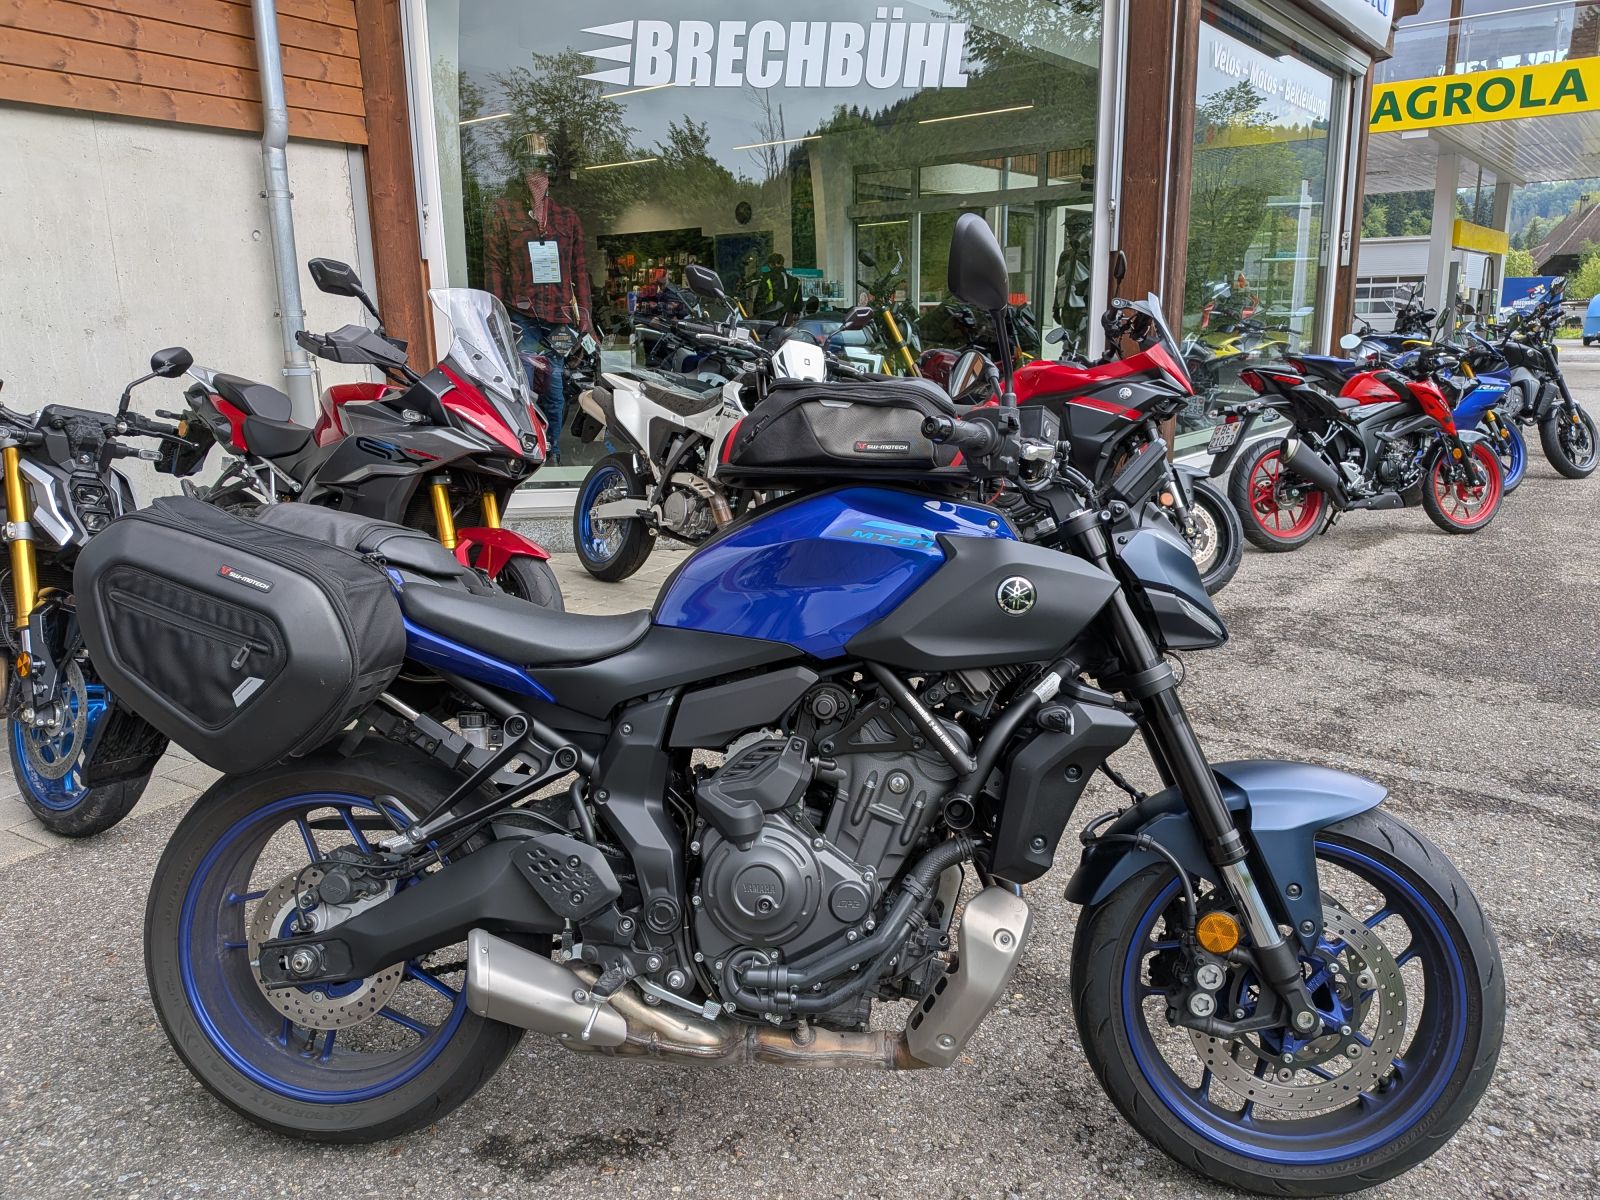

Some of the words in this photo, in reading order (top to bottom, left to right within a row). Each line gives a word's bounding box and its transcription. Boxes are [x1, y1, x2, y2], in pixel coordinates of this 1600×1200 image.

[633, 7, 969, 89] BRECHBÜHL
[1213, 40, 1241, 78] Velos
[1249, 60, 1277, 95] Motos
[1284, 79, 1326, 122] Bekleidung
[1370, 68, 1588, 125] AGROLA
[1220, 424, 1231, 435] BE
[851, 530, 935, 549] MT-07
[229, 571, 270, 589] SW-MOTECH
[743, 882, 776, 894] YAMAHA
